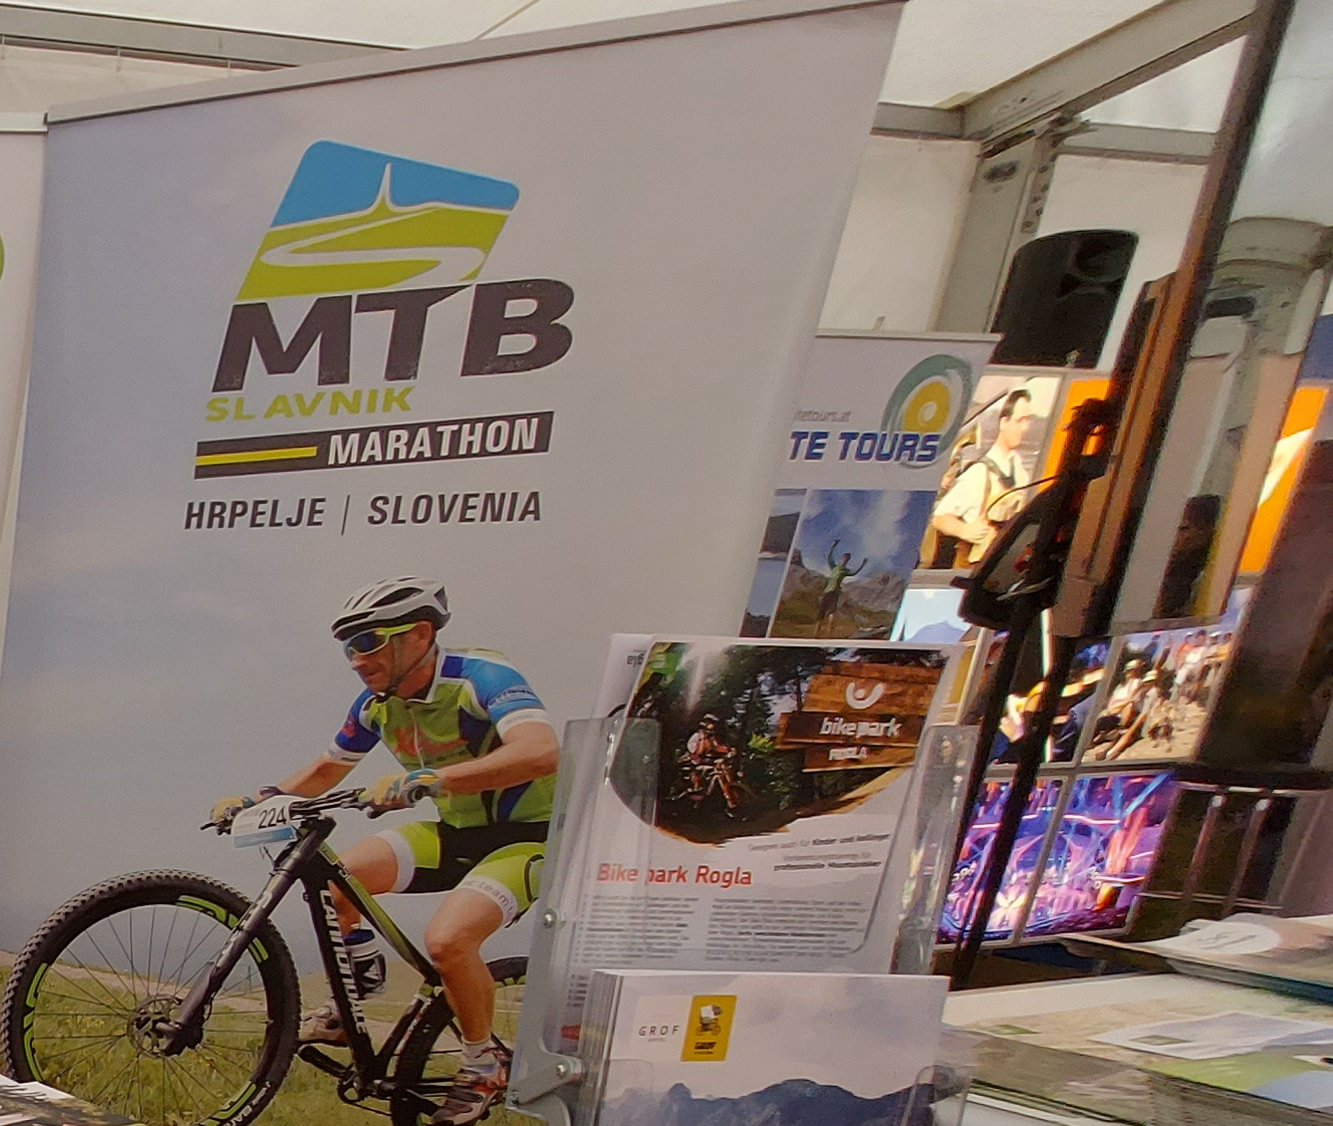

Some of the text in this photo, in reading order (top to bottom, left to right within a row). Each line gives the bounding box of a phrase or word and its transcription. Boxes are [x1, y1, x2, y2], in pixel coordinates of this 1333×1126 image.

[212, 278, 574, 392] MTB
[205, 386, 416, 422] SLAVNIK
[328, 417, 540, 465] MARATHON
[838, 432, 941, 462] TOURS
[185, 491, 541, 530] HRPELJE SLOVENIA
[258, 808, 287, 830] 224
[597, 863, 638, 883] Bike
[696, 865, 752, 888] Rogla
[638, 1025, 679, 1036] GROF
